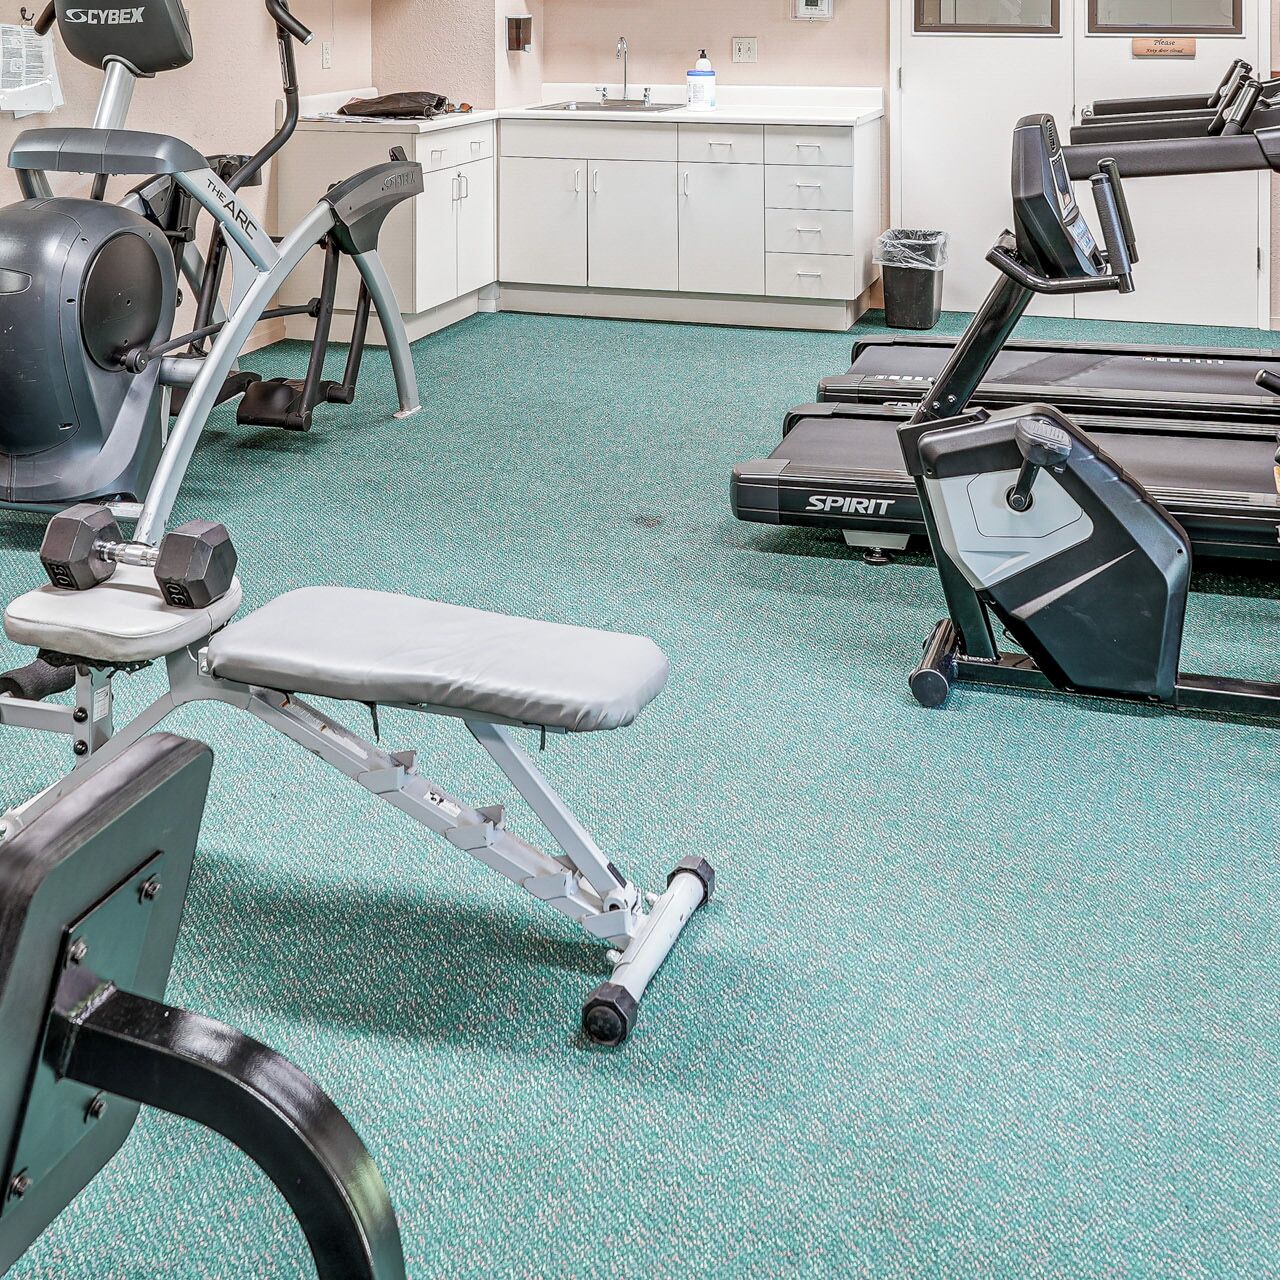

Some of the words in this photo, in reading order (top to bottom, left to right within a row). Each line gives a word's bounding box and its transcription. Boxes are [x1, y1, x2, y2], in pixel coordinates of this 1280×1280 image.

[87, 7, 145, 24] CYBEX
[207, 178, 227, 203] THE
[223, 200, 258, 240] ARC
[805, 495, 896, 515] SPIRIT
[54, 563, 71, 586] 30
[169, 582, 188, 608] 30
